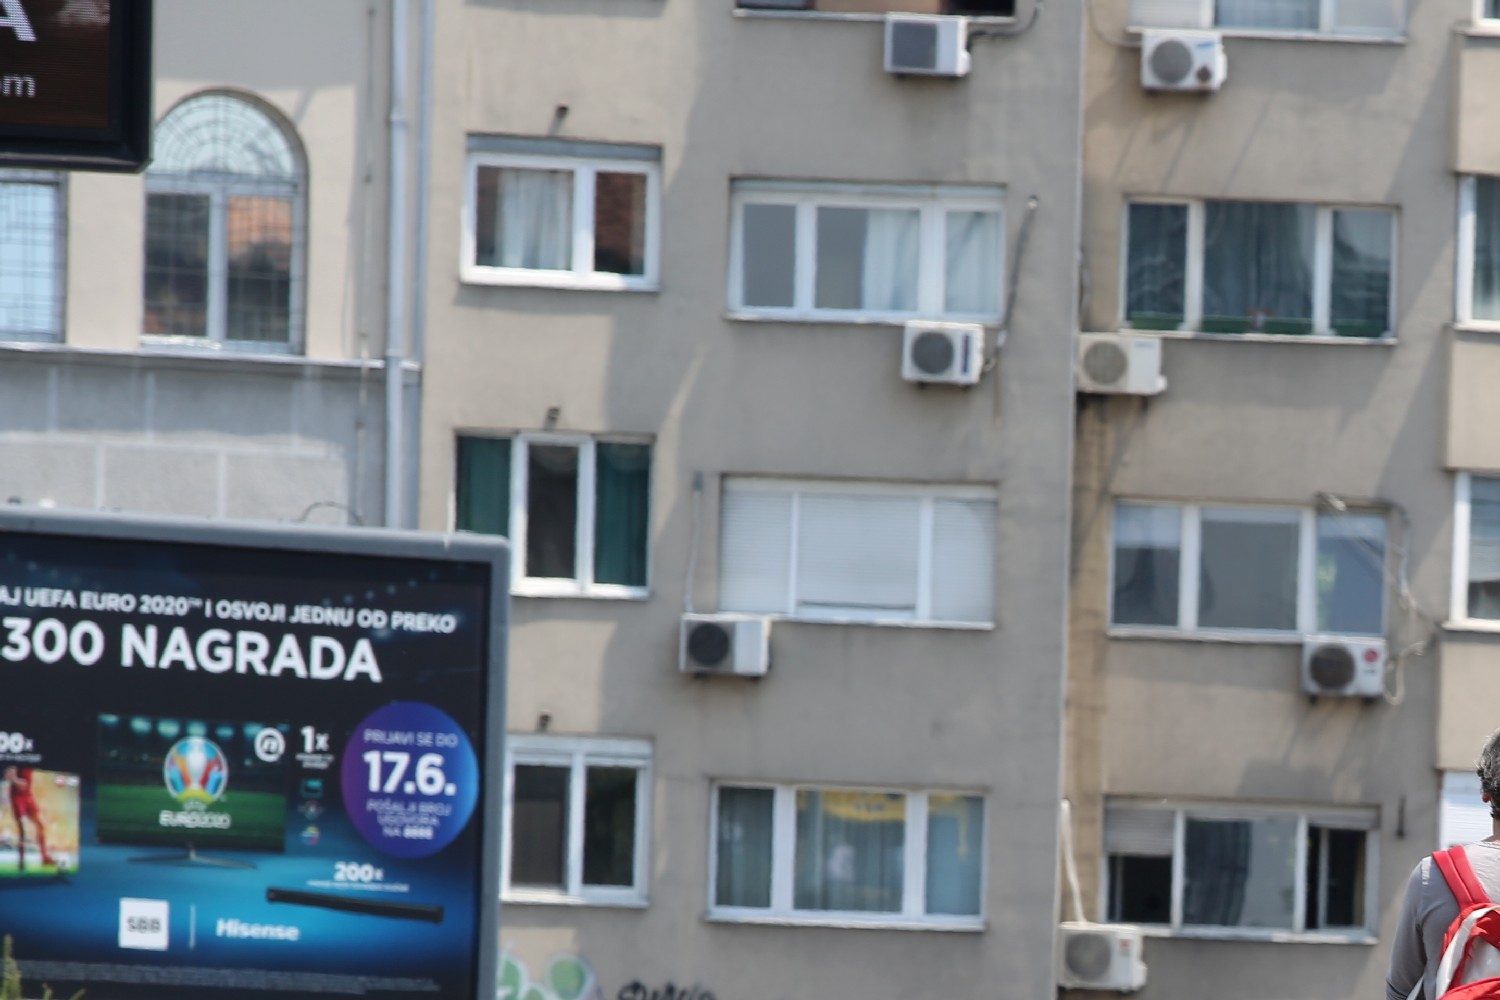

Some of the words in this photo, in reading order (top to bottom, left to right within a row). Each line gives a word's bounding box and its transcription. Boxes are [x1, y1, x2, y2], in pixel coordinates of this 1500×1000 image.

[24, 587, 77, 609] UEFA
[79, 590, 136, 612] EURO
[215, 600, 285, 622] OSVOJI
[289, 605, 354, 627] JEDNU
[357, 609, 388, 629] OD
[391, 611, 456, 634] PREKO
[1, 616, 105, 666] 300
[120, 623, 383, 683] NAGRADA
[363, 750, 457, 796] 17.6.
[216, 918, 300, 941] Hisense
